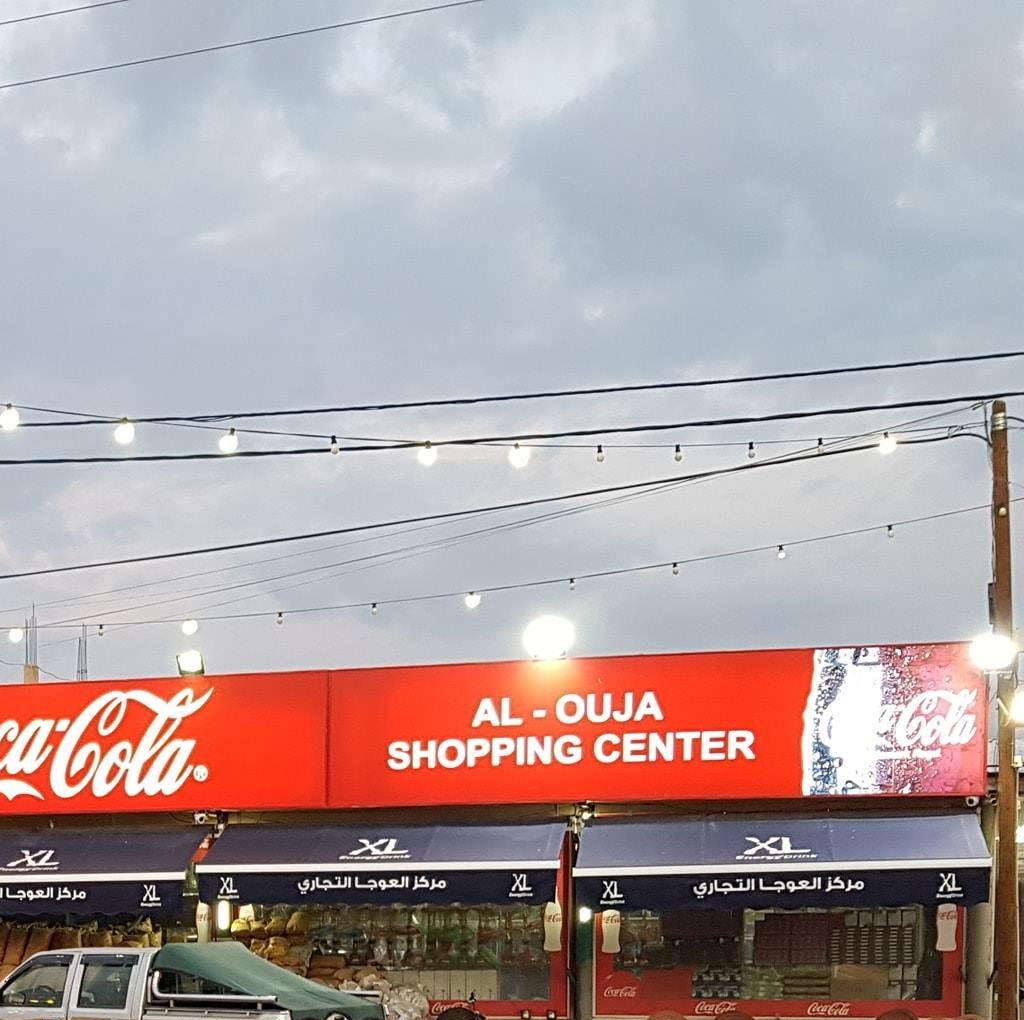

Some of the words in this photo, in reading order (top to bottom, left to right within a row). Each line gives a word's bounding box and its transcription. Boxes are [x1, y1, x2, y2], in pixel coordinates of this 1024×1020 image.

[471, 697, 523, 728] AL
[555, 691, 664, 724] OUJA
[387, 735, 582, 771] SHOPPING
[593, 730, 756, 764] CENTER
[348, 838, 409, 856] XL
[743, 836, 812, 855] XL
[5, 849, 60, 868] XL
[220, 876, 239, 895] XL
[297, 876, 352, 895] التجاري
[412, 875, 447, 892] مركز
[511, 873, 533, 892] XL
[602, 880, 625, 899] XL
[693, 878, 756, 897] التجاري
[824, 876, 865, 893] مركز
[938, 872, 963, 893] XL
[55, 886, 87, 901] مركز
[142, 884, 161, 902] XL
